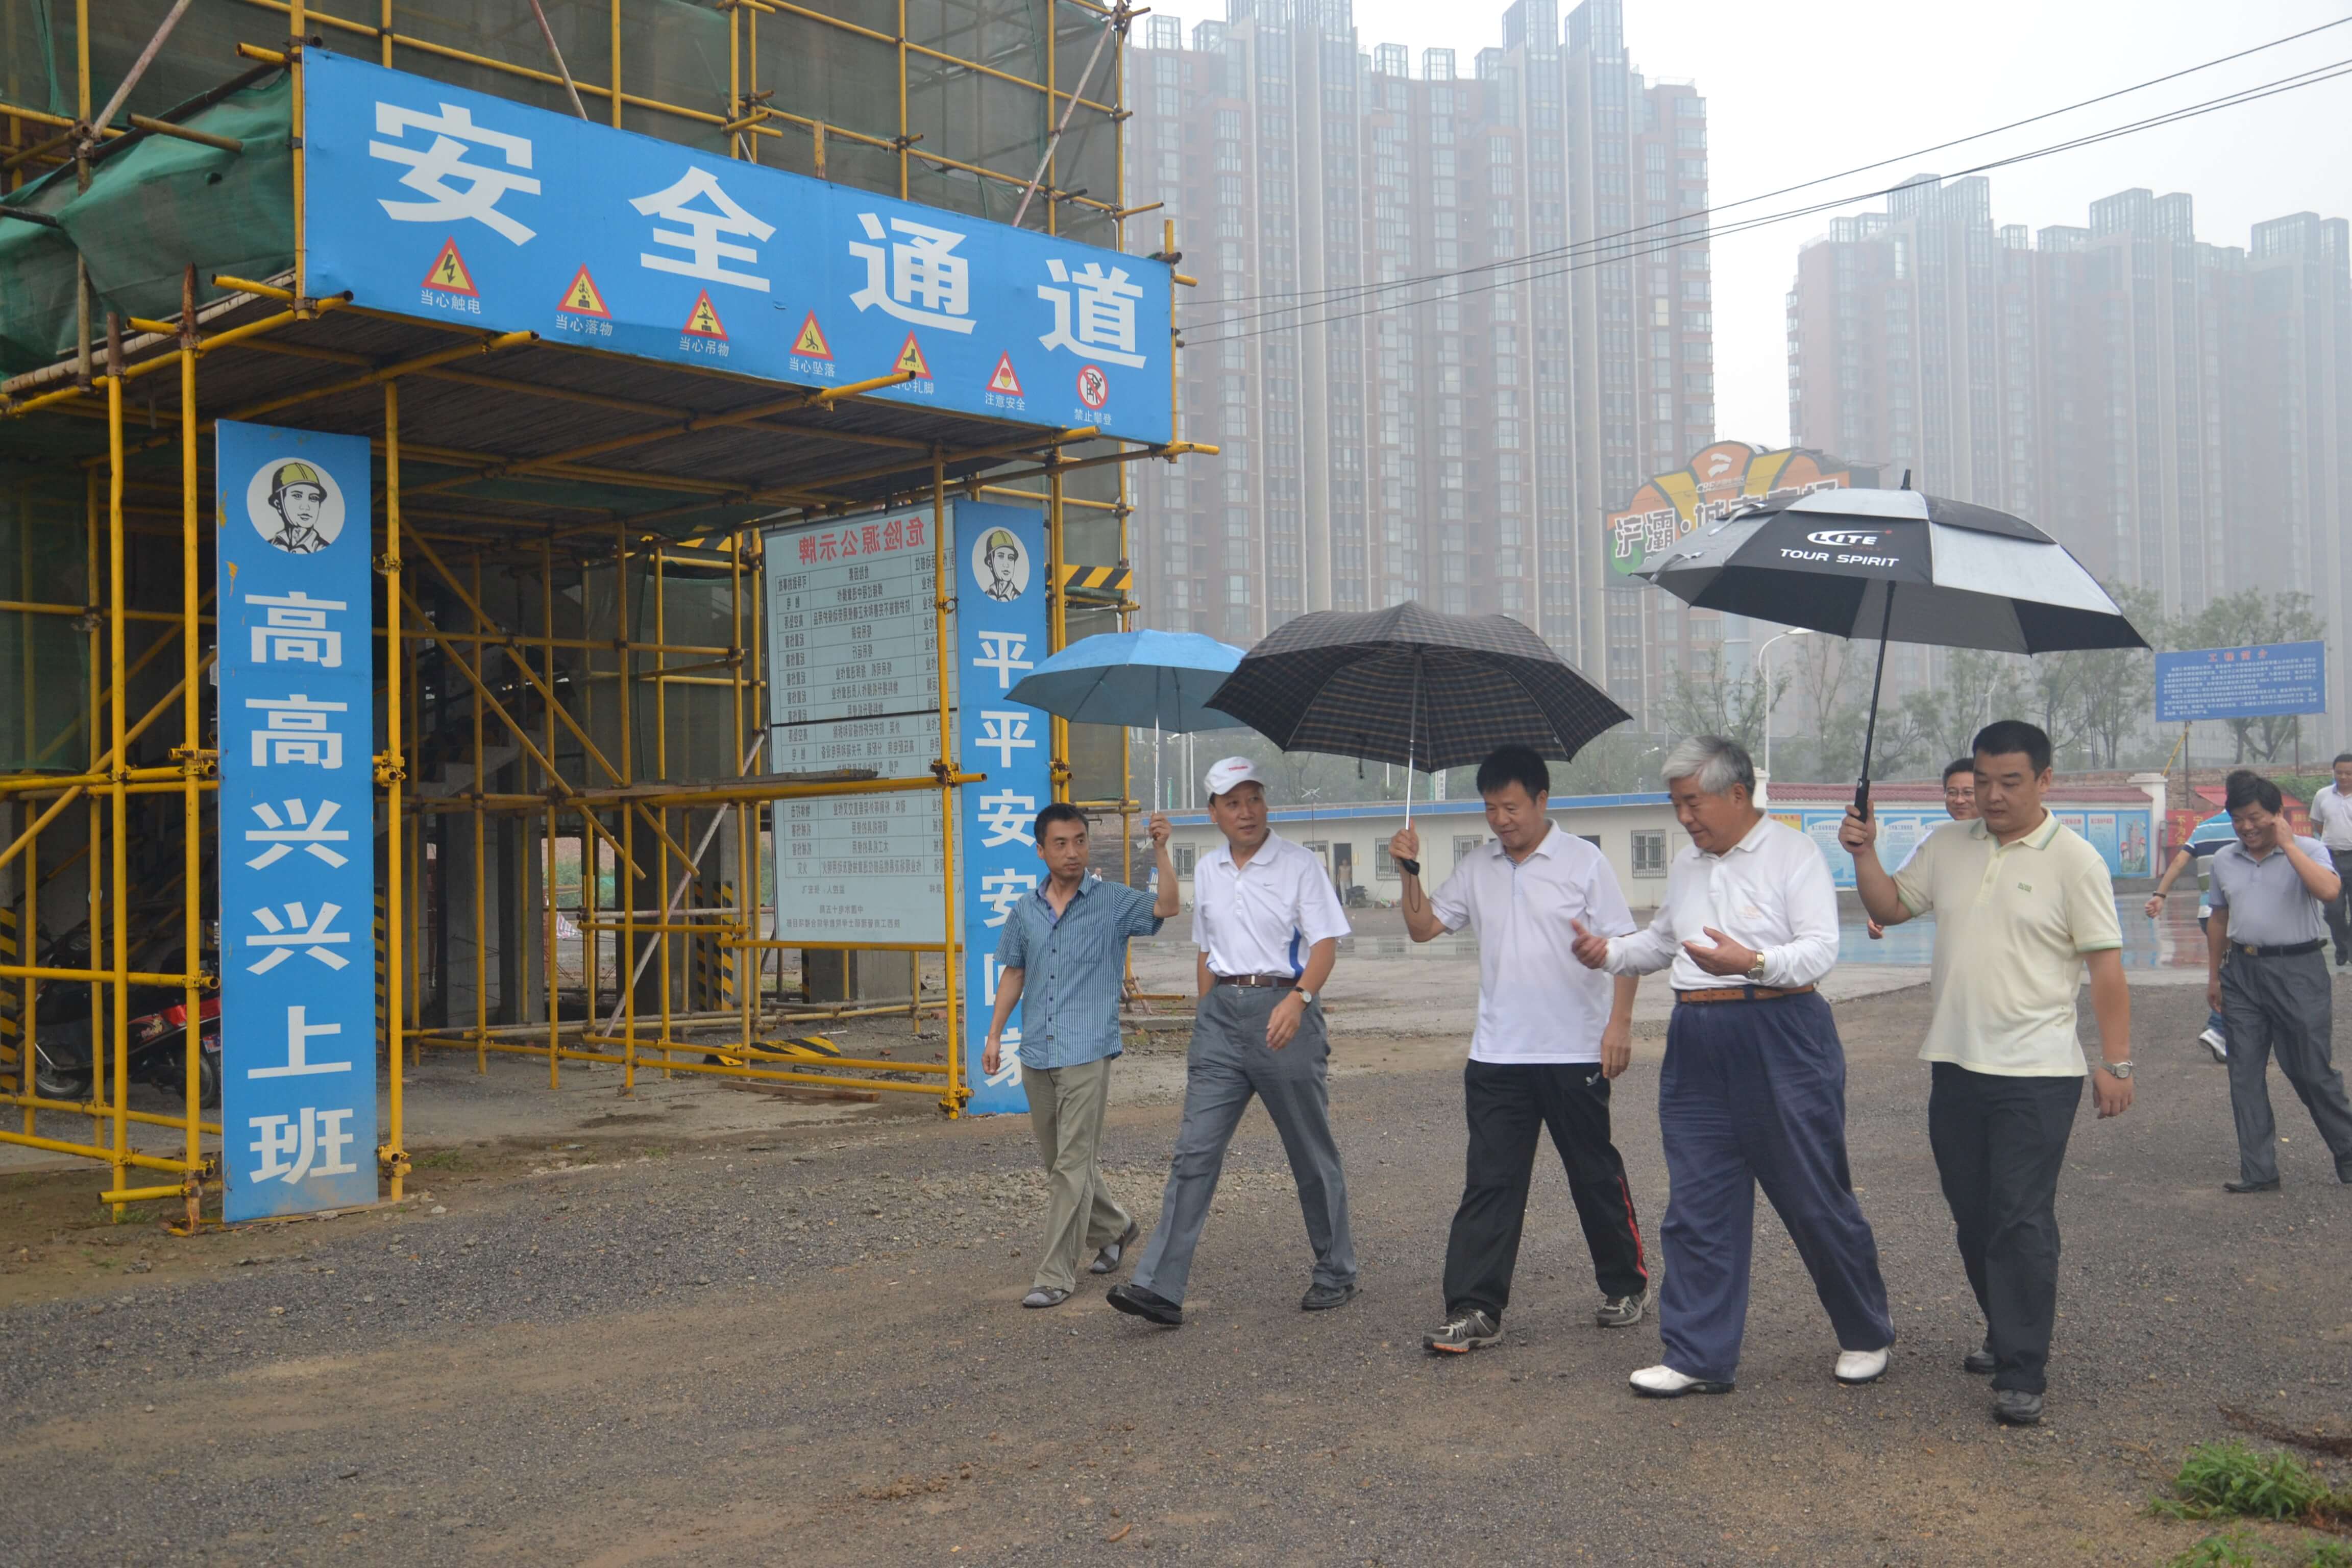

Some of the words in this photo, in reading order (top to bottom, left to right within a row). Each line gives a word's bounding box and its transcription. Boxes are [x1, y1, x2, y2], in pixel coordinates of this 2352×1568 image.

[369, 101, 1147, 369] 安全通道
[421, 290, 481, 315] 当心触电
[555, 314, 613, 337] 当心落物
[679, 336, 730, 358] 当心吊物
[789, 357, 836, 378] 当心坠落
[985, 392, 1026, 412] 注意安全
[1074, 407, 1113, 426] 禁止攀登
[1814, 533, 1878, 545] LITE
[1780, 548, 1830, 561] TOUR
[1836, 554, 1899, 567] SPIRIT
[244, 591, 357, 1185] 高高兴兴上班
